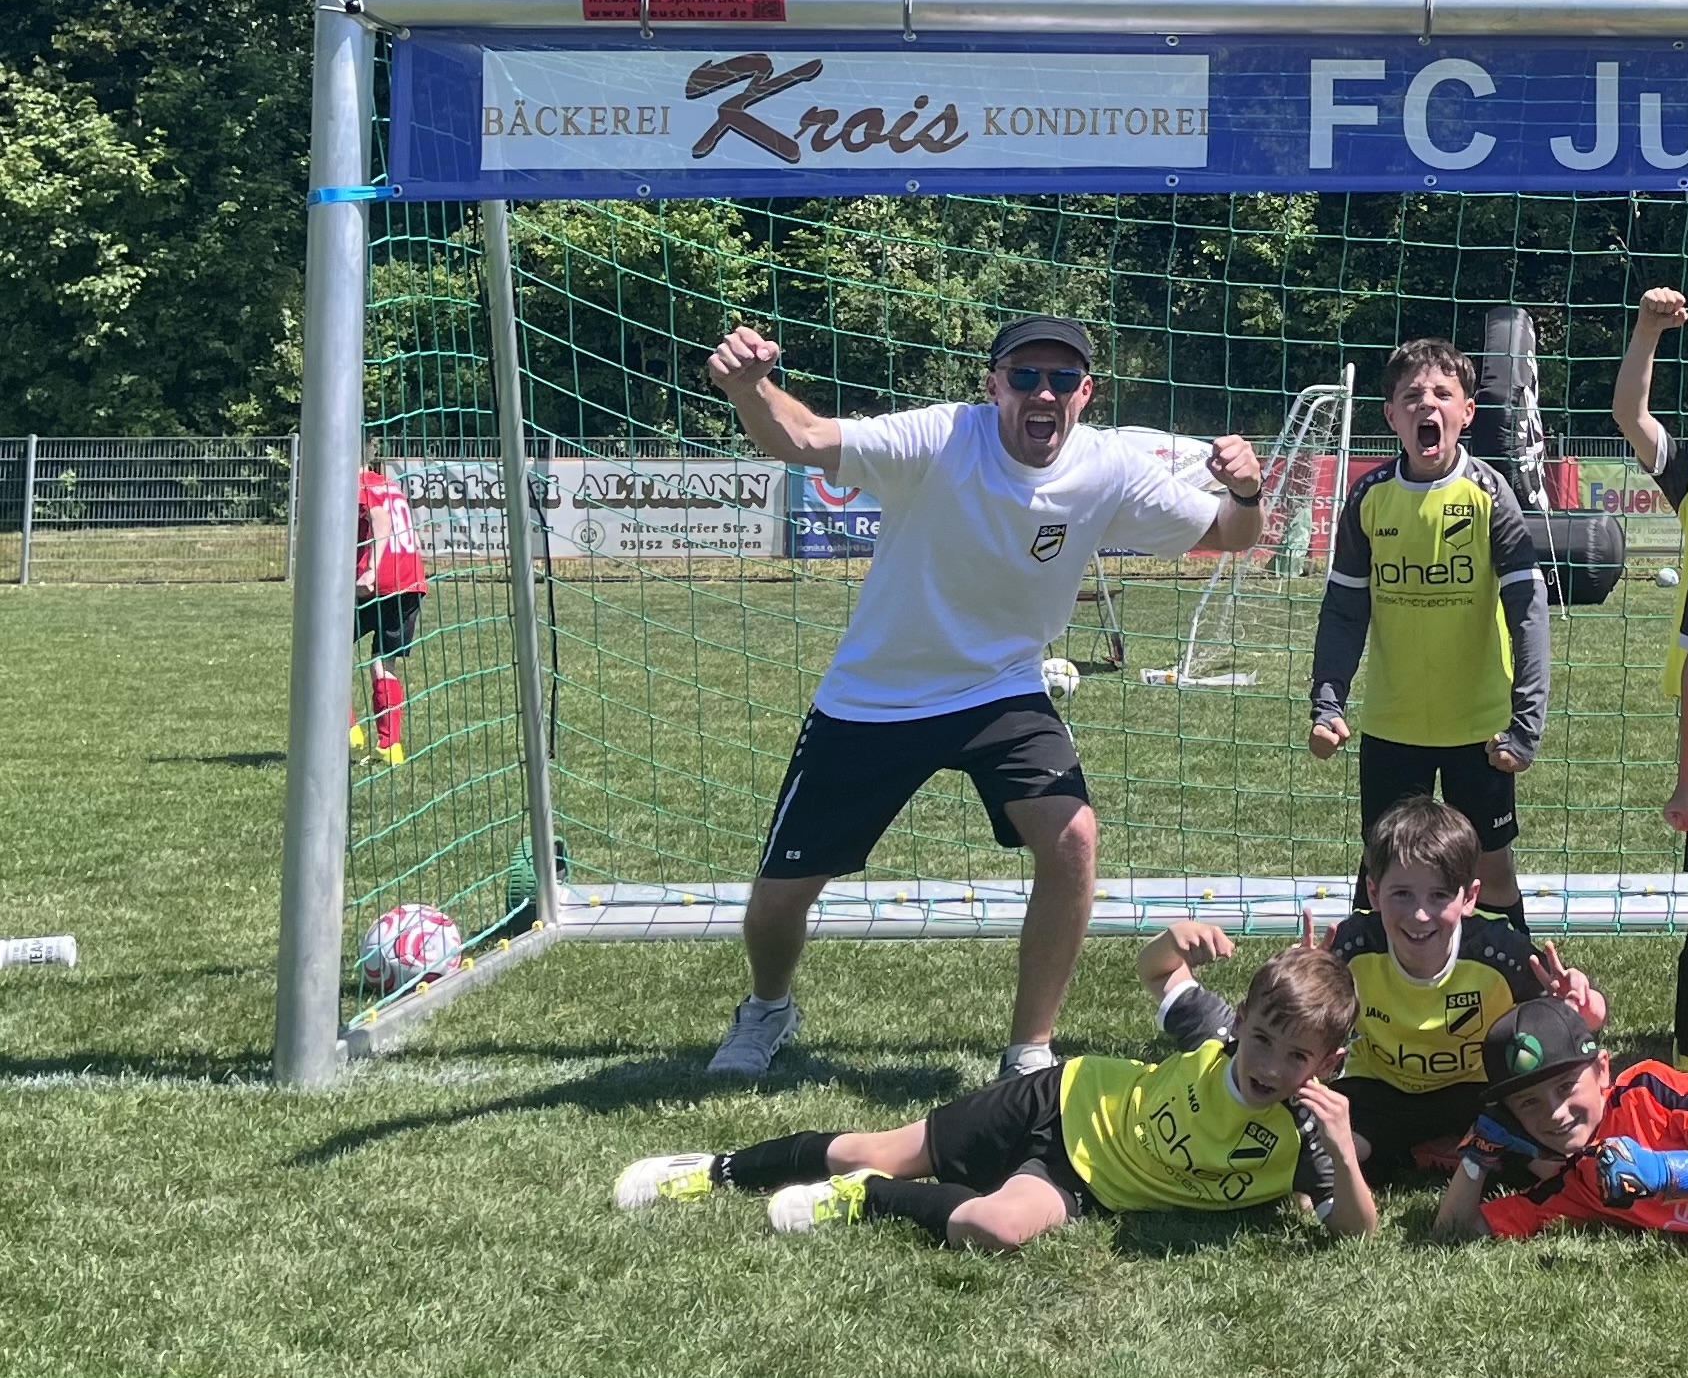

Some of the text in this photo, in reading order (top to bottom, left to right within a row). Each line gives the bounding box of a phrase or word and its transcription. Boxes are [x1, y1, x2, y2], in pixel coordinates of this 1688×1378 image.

[591, 7, 747, 18] www.keuschner.de
[482, 53, 1209, 164] BÄCKEREI Krois KONDITOREI
[1309, 58, 1497, 170] FC
[403, 473, 771, 509] Bäckeei ALTMANN
[1445, 505, 1472, 516] SGH
[722, 522, 750, 533] Str.
[754, 523, 762, 534] 3
[796, 516, 845, 536] Dein
[1448, 993, 1479, 1007] SGH
[1365, 1007, 1391, 1023] JAKO
[1247, 1124, 1277, 1149] SGH
